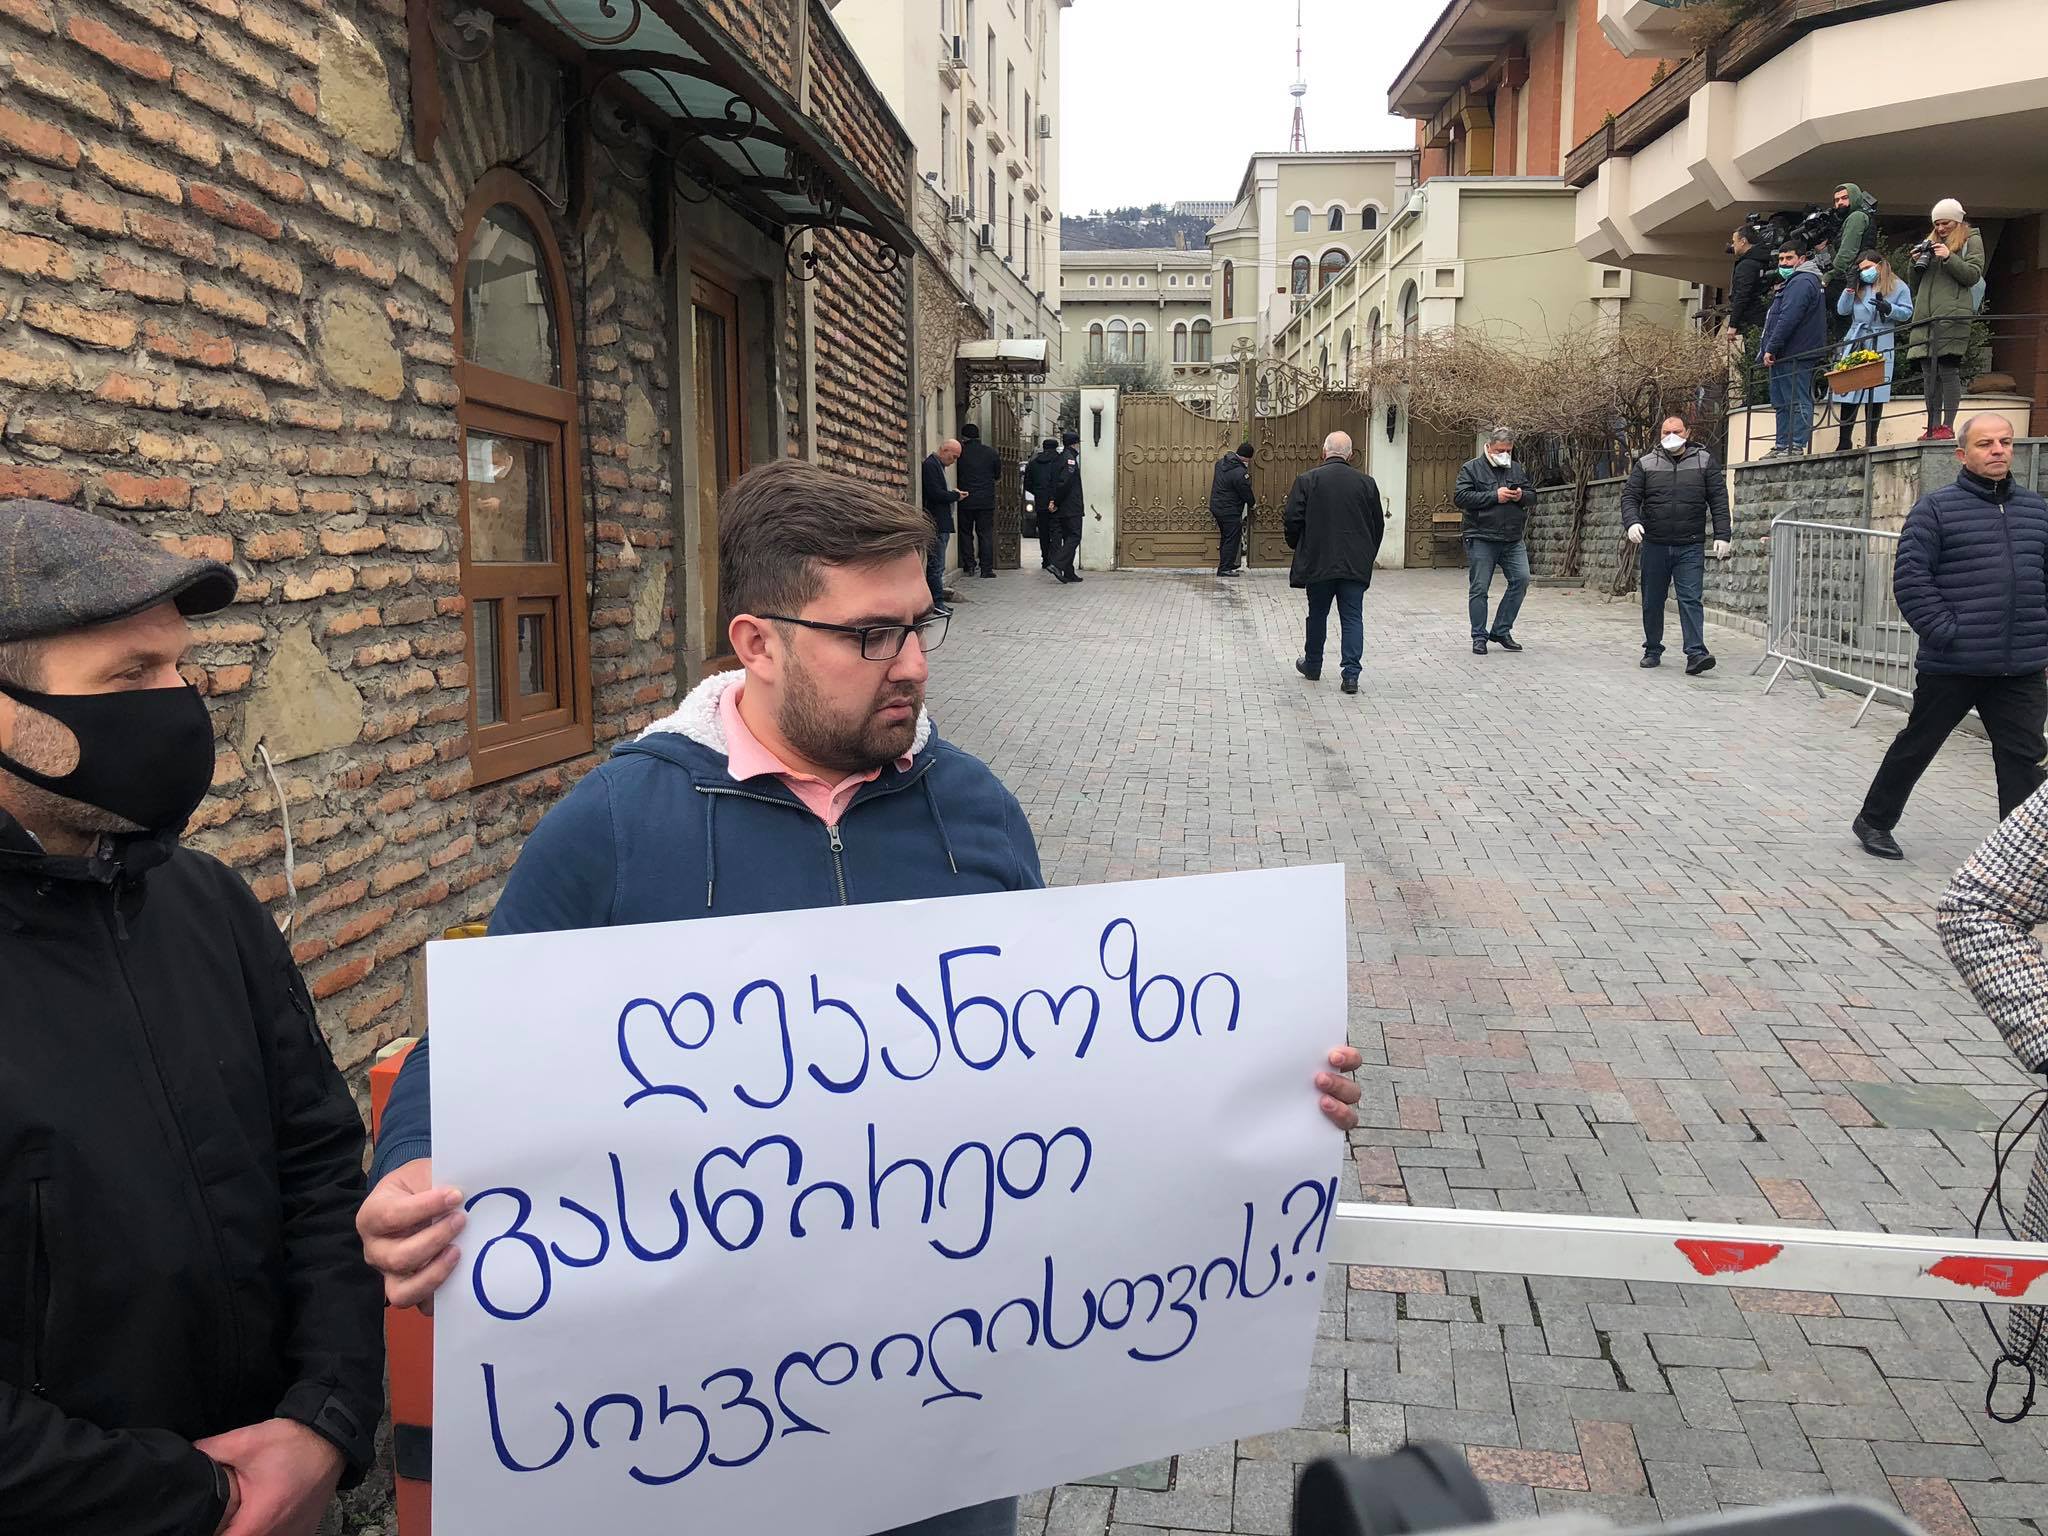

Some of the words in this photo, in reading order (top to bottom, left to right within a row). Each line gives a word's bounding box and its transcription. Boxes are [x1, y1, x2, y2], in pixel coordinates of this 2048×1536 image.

[616, 917, 1241, 1114] დეკანოზი
[463, 1122, 1093, 1321] გასწირეთ
[1982, 1280, 2012, 1290] CAME
